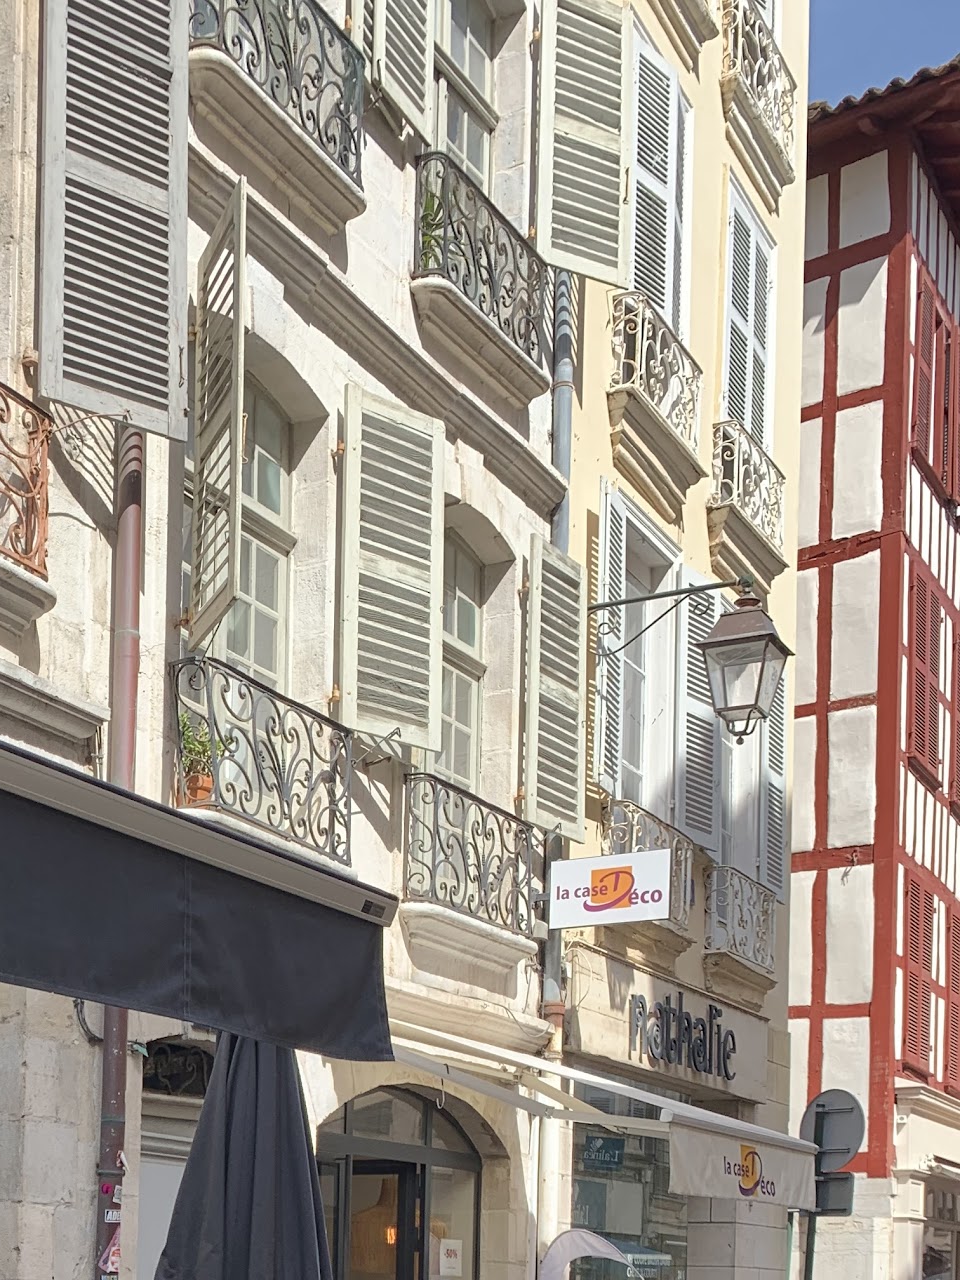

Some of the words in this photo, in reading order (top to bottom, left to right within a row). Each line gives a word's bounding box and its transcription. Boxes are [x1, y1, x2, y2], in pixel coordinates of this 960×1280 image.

[556, 886, 570, 900] la
[574, 884, 608, 899] case
[723, 1155, 732, 1175] la
[733, 1163, 750, 1178] case
